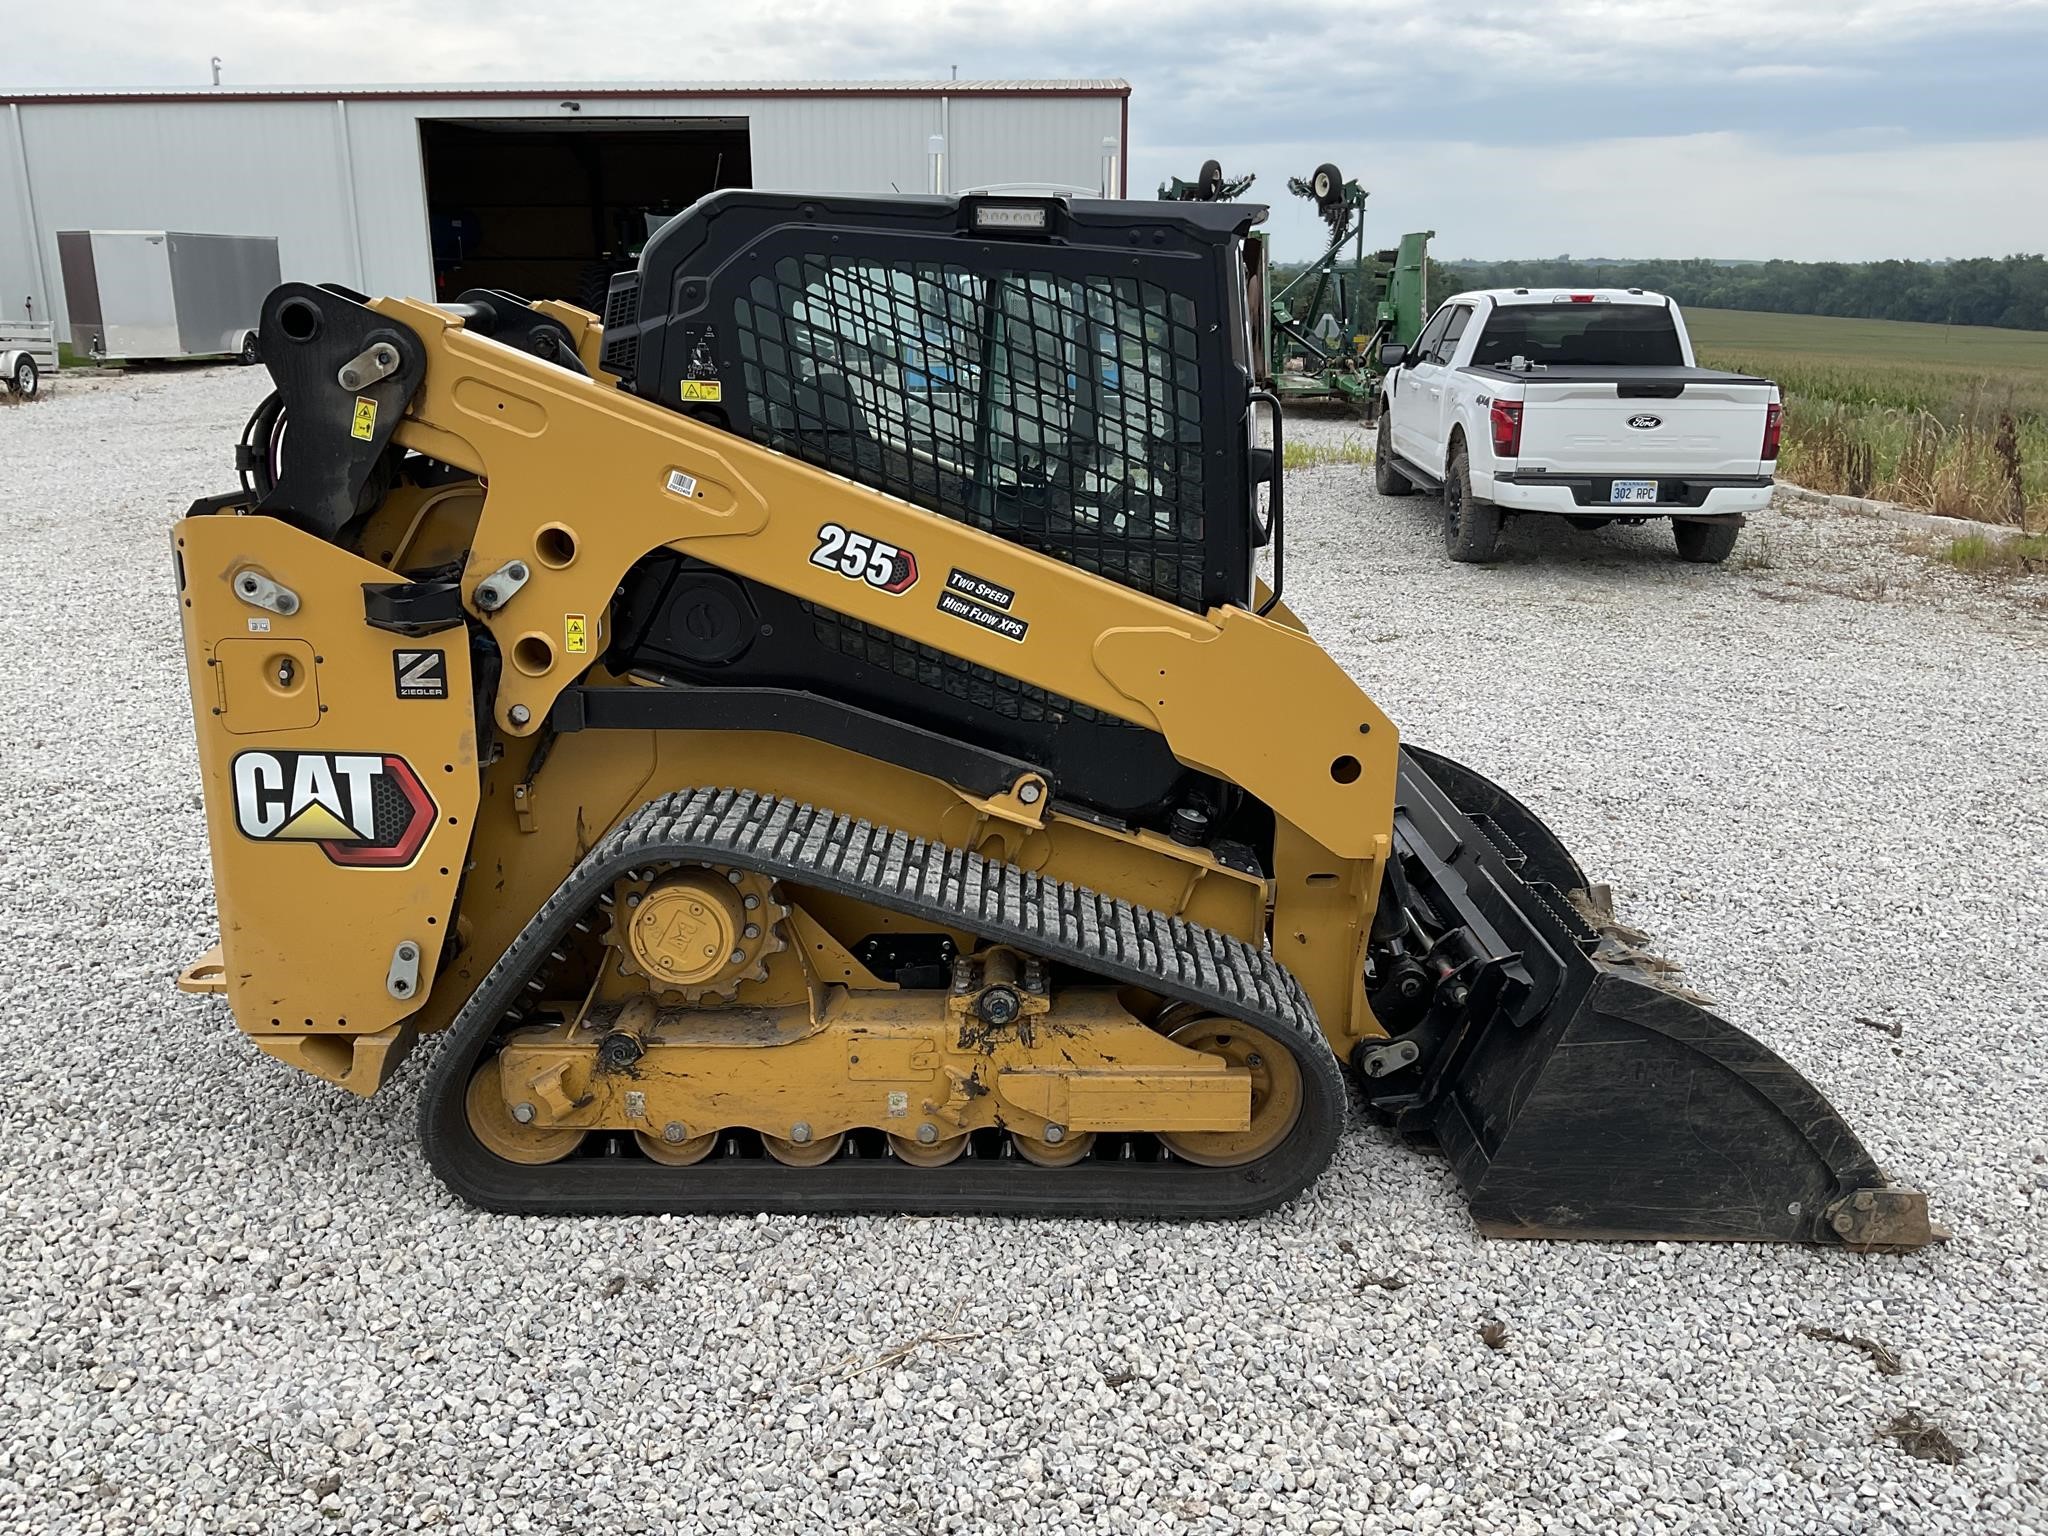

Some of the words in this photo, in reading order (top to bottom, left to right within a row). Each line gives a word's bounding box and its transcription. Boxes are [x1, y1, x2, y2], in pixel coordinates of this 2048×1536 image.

[1632, 417, 1657, 427] Ford
[1614, 488, 1631, 499] 302
[1636, 488, 1655, 499] RPC
[812, 525, 898, 586] 255
[998, 618, 1023, 635] XPS
[234, 752, 383, 840] CAT
